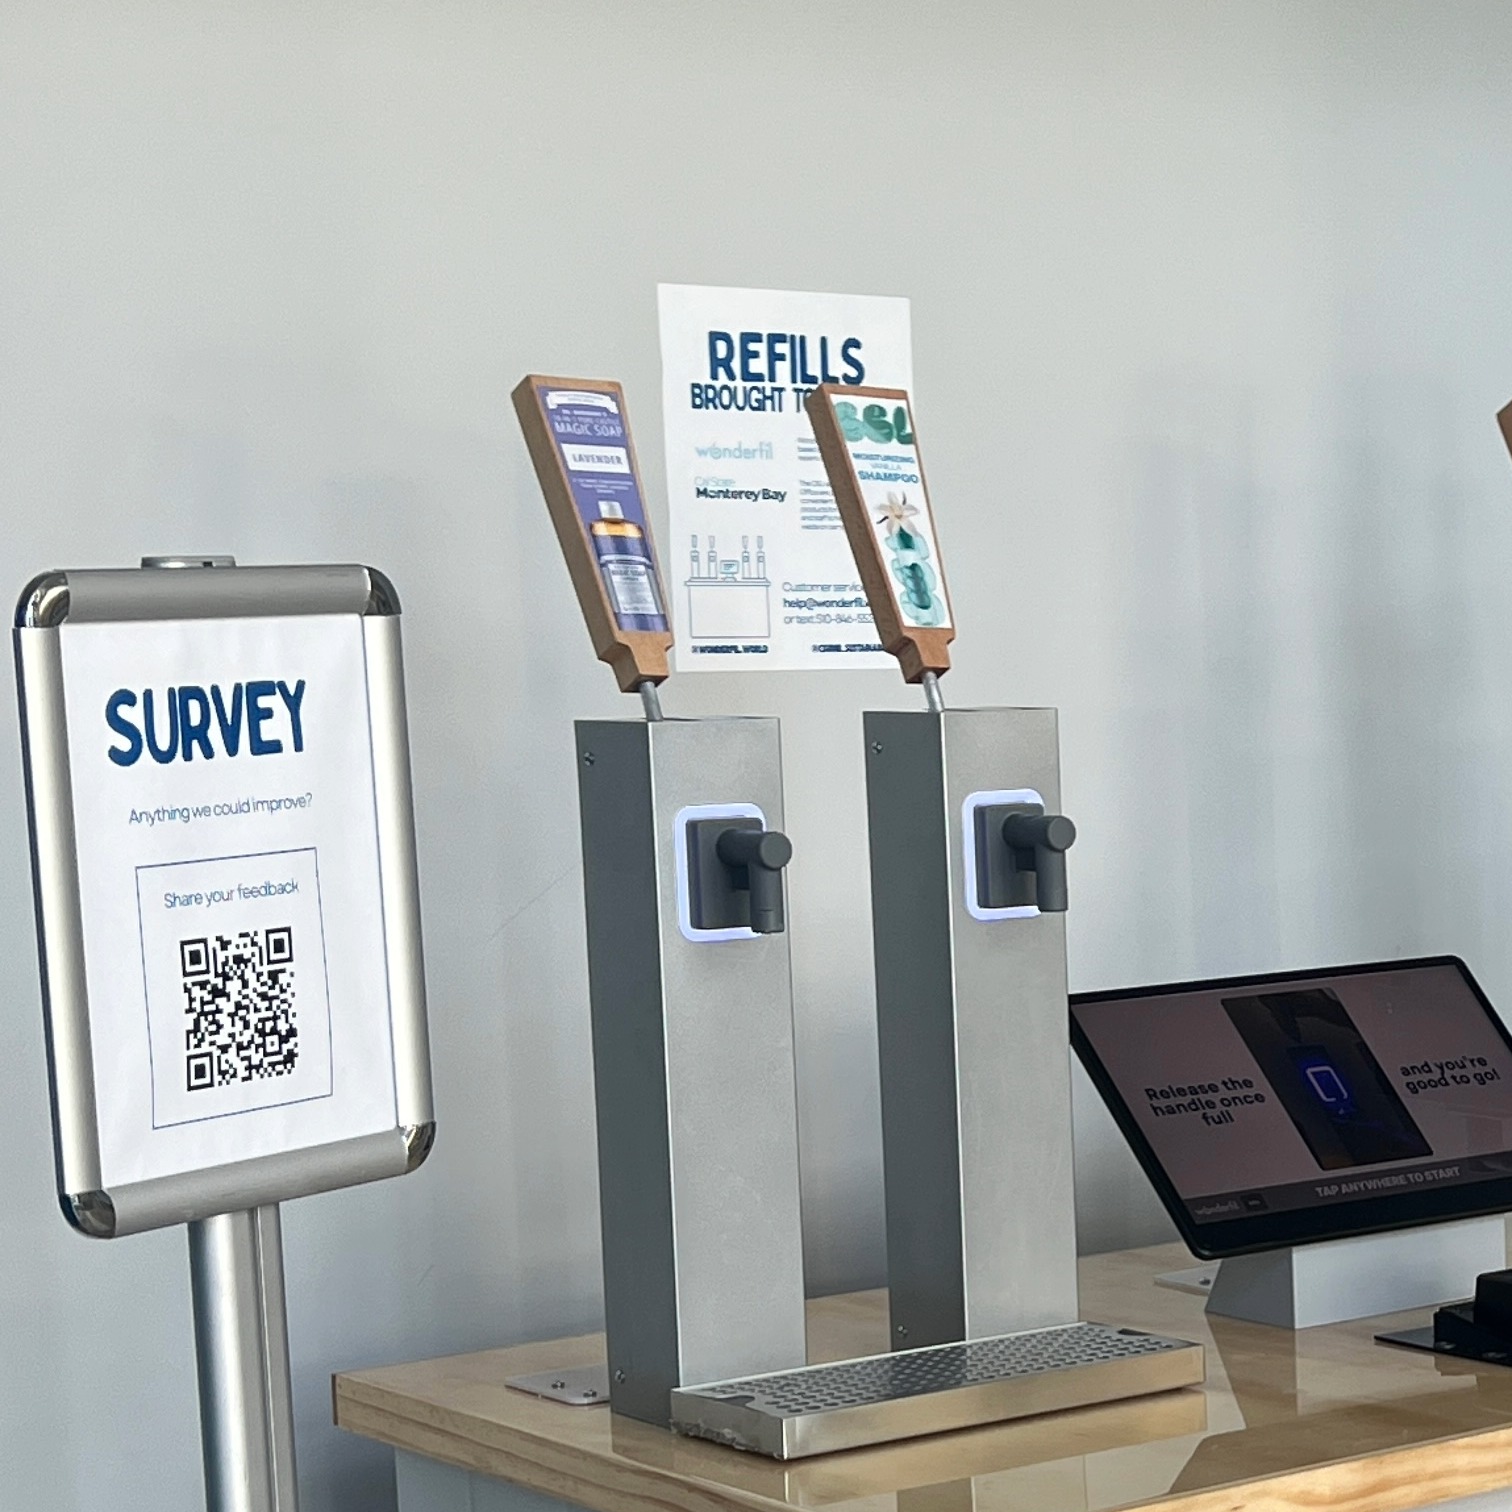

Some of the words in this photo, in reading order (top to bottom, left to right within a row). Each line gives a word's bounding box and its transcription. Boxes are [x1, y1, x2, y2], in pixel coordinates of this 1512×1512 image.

[708, 331, 865, 385] REFILLS
[690, 383, 786, 412] BROUGHT
[793, 386, 815, 412] T
[554, 422, 592, 435] MAGIC
[593, 424, 622, 437] SOAP
[572, 453, 623, 465] LAVENDER
[695, 441, 773, 460] wonderfil
[858, 470, 919, 484] SHAMPOO
[696, 487, 760, 502] Monterey
[761, 488, 787, 502] Bay
[105, 678, 306, 767] SURVEY
[129, 804, 190, 826] Anything
[190, 804, 211, 819] we
[213, 797, 251, 818] could
[251, 791, 313, 819] improve?
[164, 889, 203, 910] Share
[205, 884, 234, 905] your
[237, 878, 299, 899] feedback
[1400, 1060, 1433, 1076] and
[1434, 1055, 1488, 1079] you're
[1145, 1082, 1220, 1101] Release
[1221, 1077, 1254, 1091] the
[1405, 1077, 1450, 1095] good
[1450, 1074, 1471, 1085] to
[1473, 1067, 1501, 1086] go!
[1150, 1098, 1217, 1117] handle
[1220, 1092, 1266, 1108] once
[1202, 1110, 1235, 1126] full
[1316, 1184, 1339, 1198] TAP
[1341, 1174, 1406, 1195] ANYWHERE
[1408, 1172, 1424, 1184] TO
[1425, 1166, 1460, 1182] START
